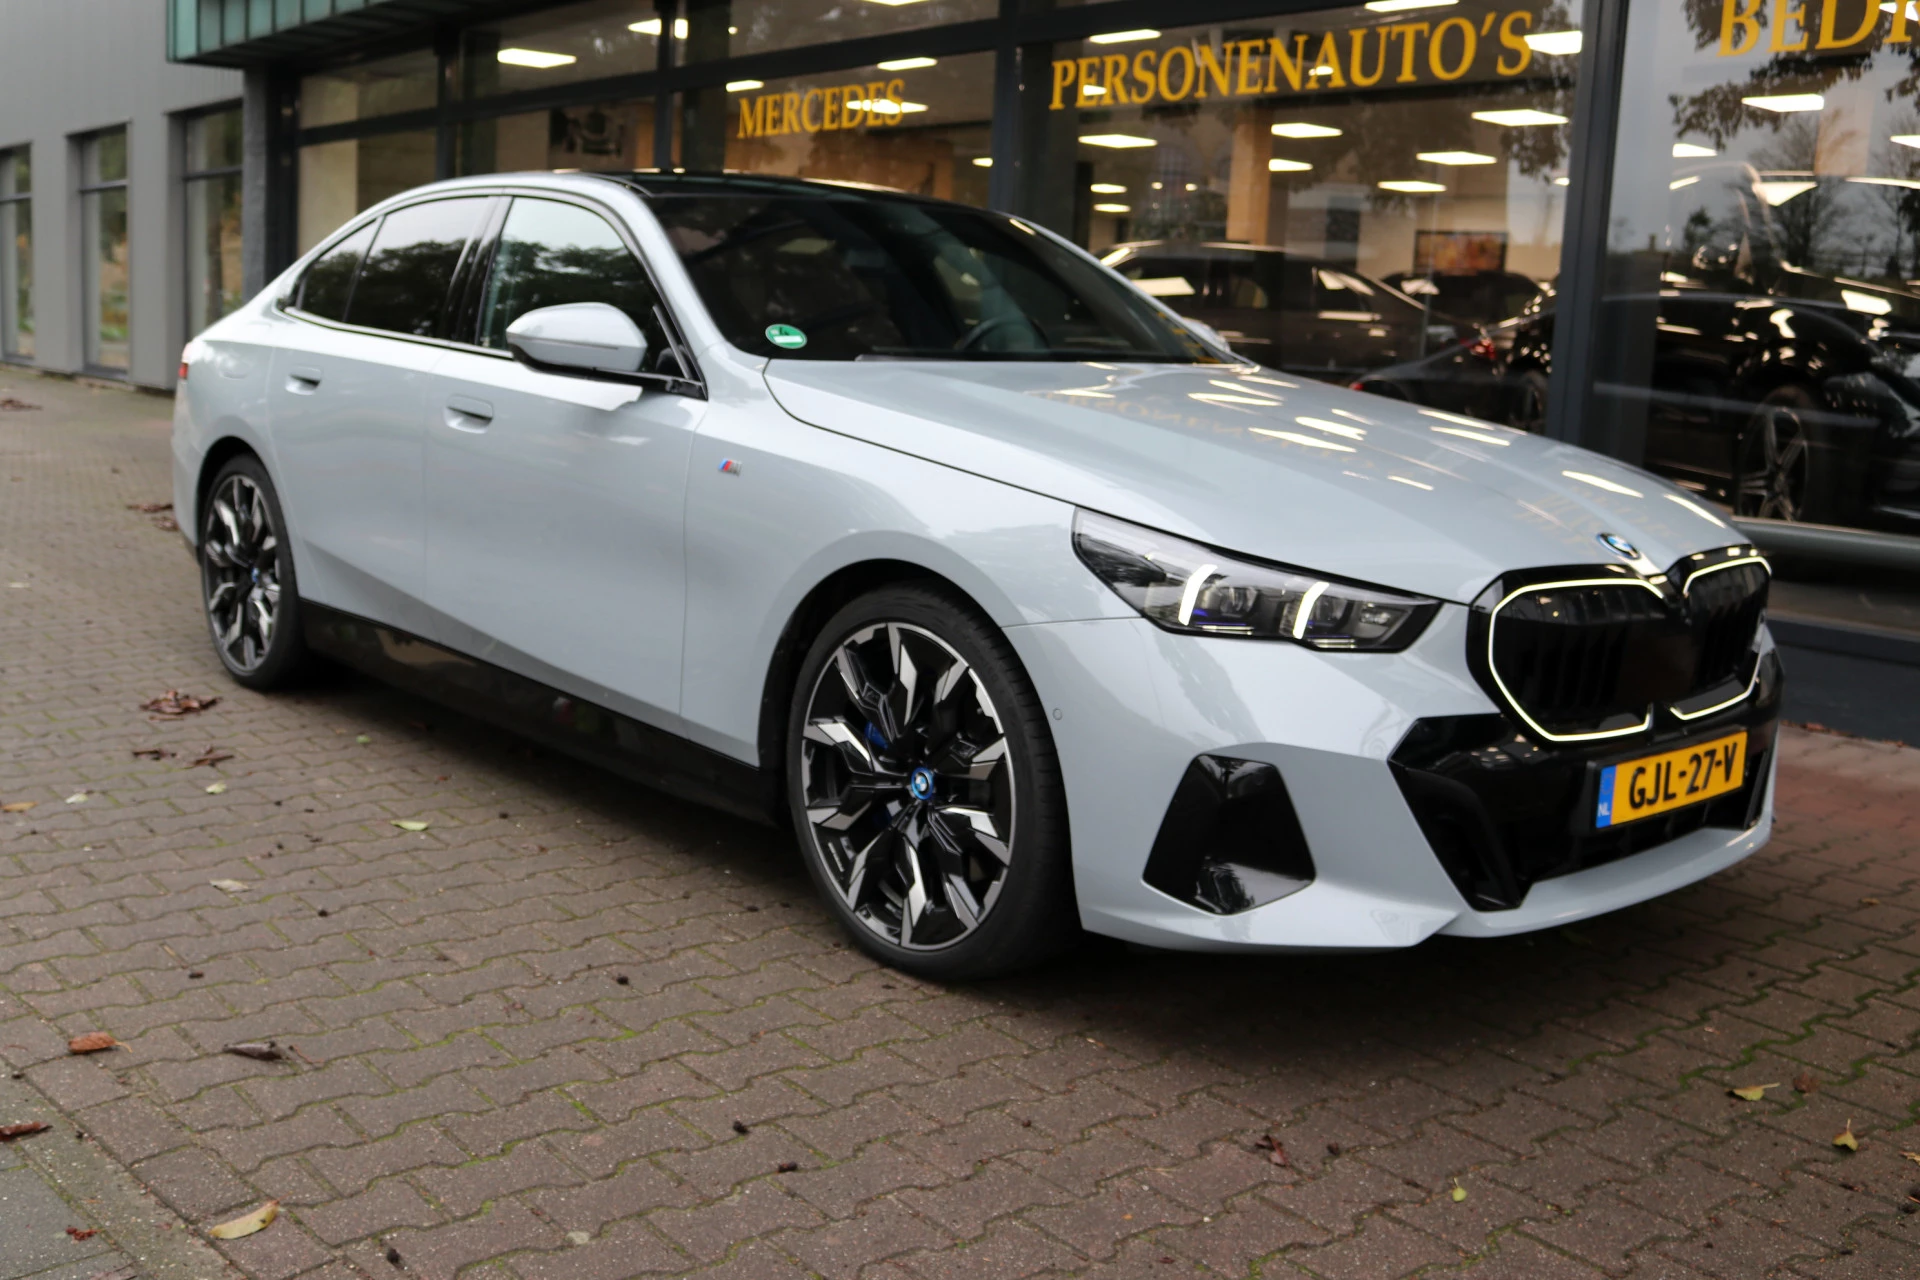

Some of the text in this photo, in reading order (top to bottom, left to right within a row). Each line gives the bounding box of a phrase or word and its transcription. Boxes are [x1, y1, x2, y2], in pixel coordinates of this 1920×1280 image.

[1049, 10, 1533, 110] PERSONENAUTO'S
[737, 78, 905, 139] MERCEDES
[1629, 742, 1738, 810] GJL-27-V
[1598, 802, 1610, 817] NL
